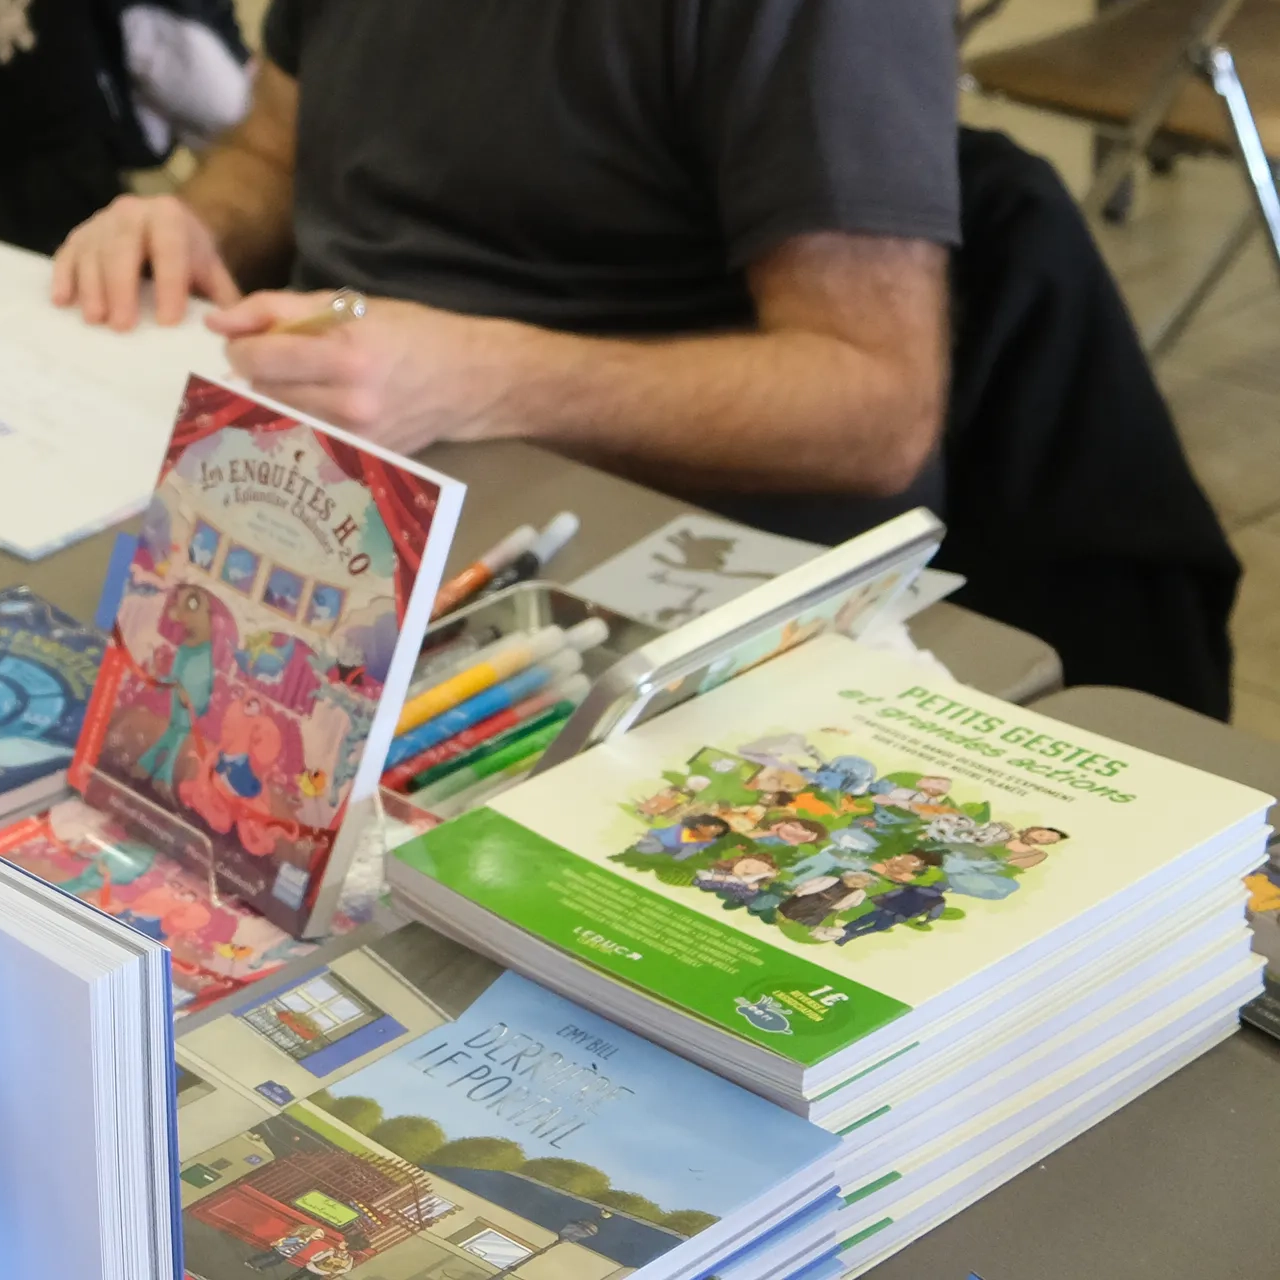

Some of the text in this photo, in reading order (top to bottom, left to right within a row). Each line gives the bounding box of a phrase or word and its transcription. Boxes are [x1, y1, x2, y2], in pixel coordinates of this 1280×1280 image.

[228, 458, 336, 522] ENQUÊTES
[875, 706, 1006, 758] grandes
[1005, 756, 1138, 804] actions
[896, 685, 1130, 778] PETITS GESTES
[463, 1021, 636, 1117] DERRIÈRE
[555, 1023, 620, 1061] EMY BILL
[408, 1042, 586, 1150] LE PORTAIL
